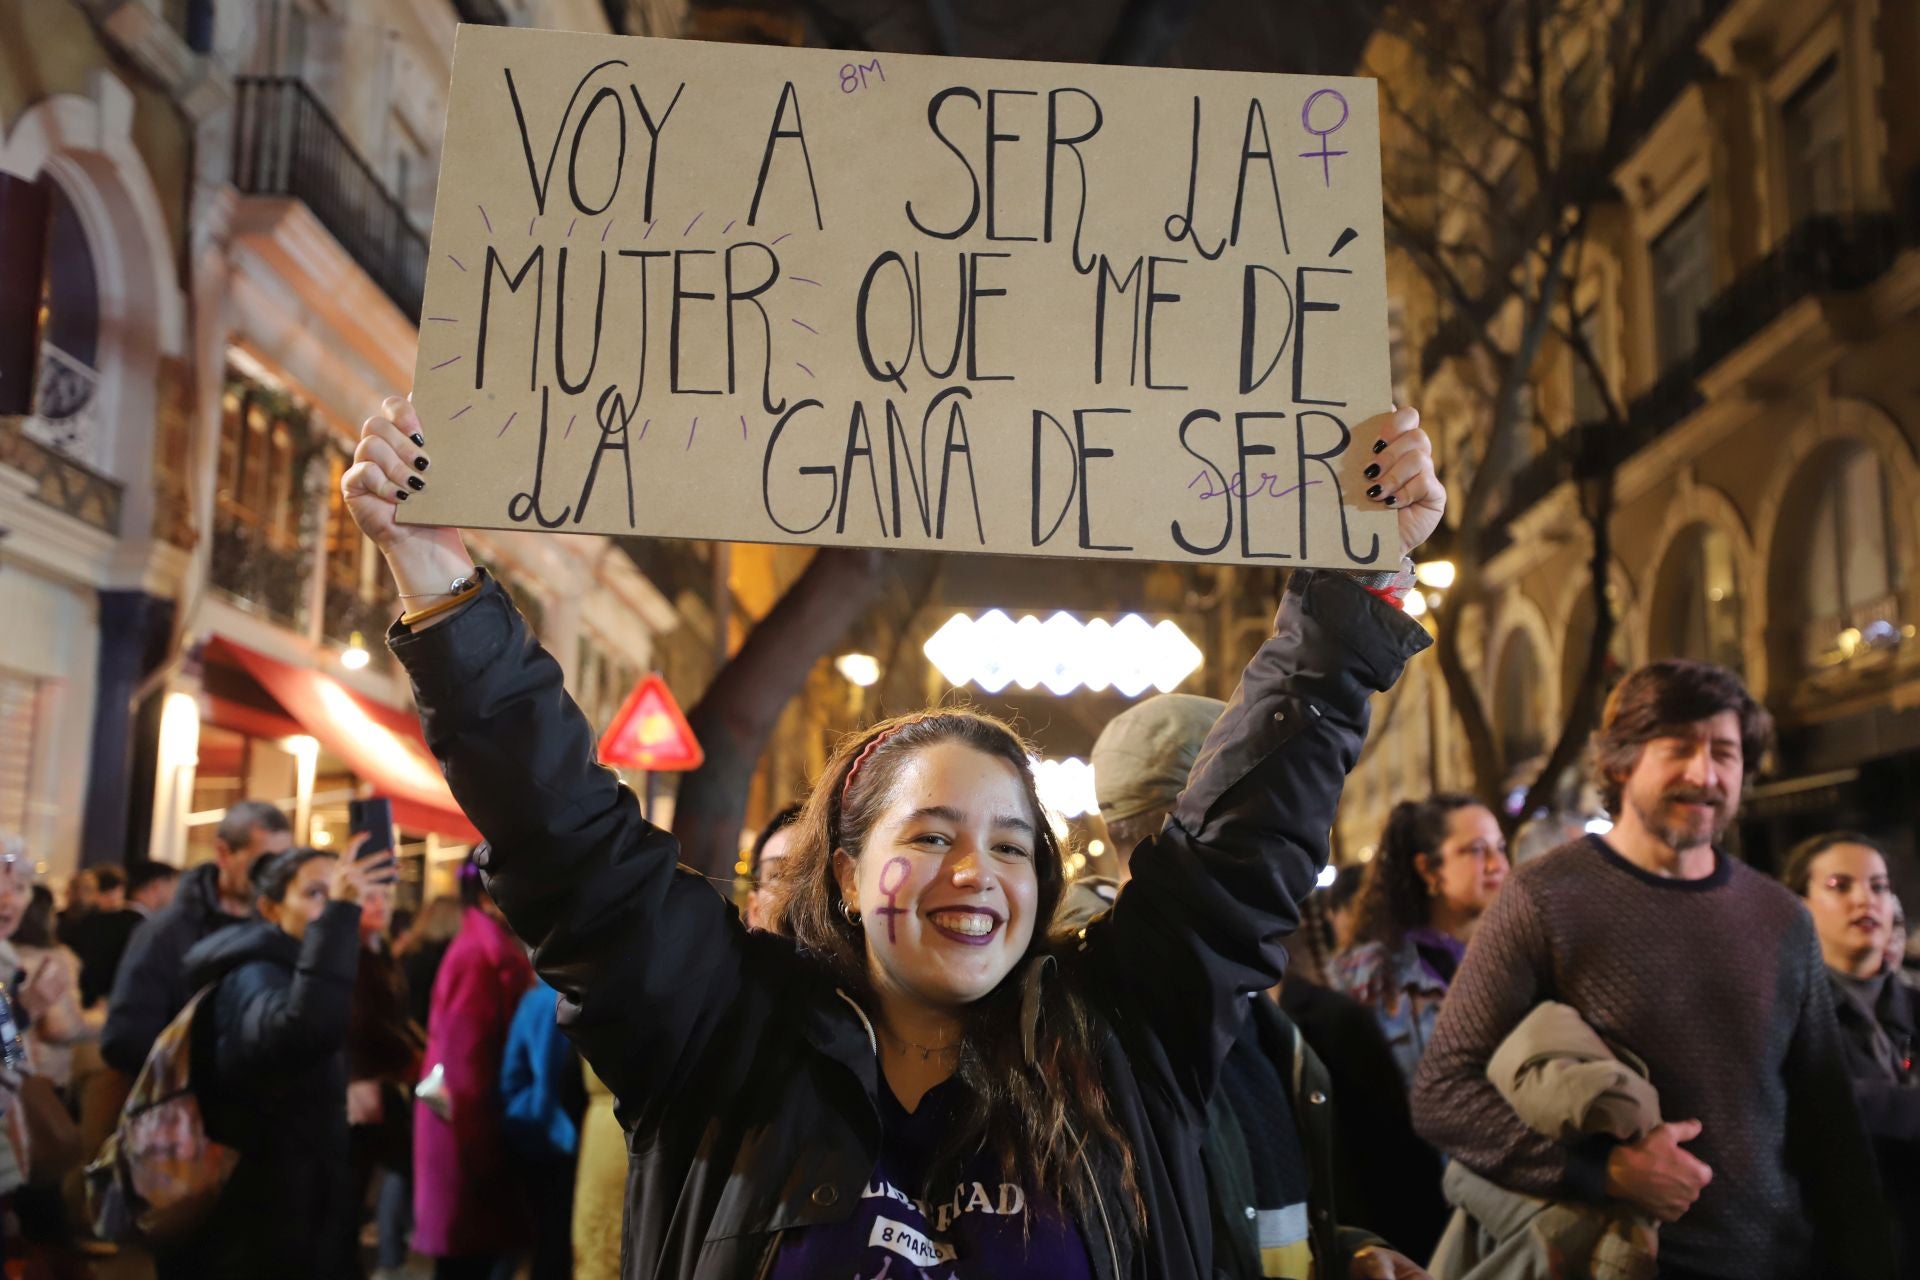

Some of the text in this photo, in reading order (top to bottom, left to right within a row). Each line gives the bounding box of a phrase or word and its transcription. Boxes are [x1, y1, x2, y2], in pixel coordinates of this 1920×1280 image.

[839, 57, 886, 95] 8M
[504, 59, 1291, 275] VOY A SER LA
[475, 227, 1359, 434] MUJER QUE ME DÉ
[507, 385, 1380, 565] LA GANA DE SER
[1187, 470, 1323, 500] ser
[881, 1226, 892, 1243] 8
